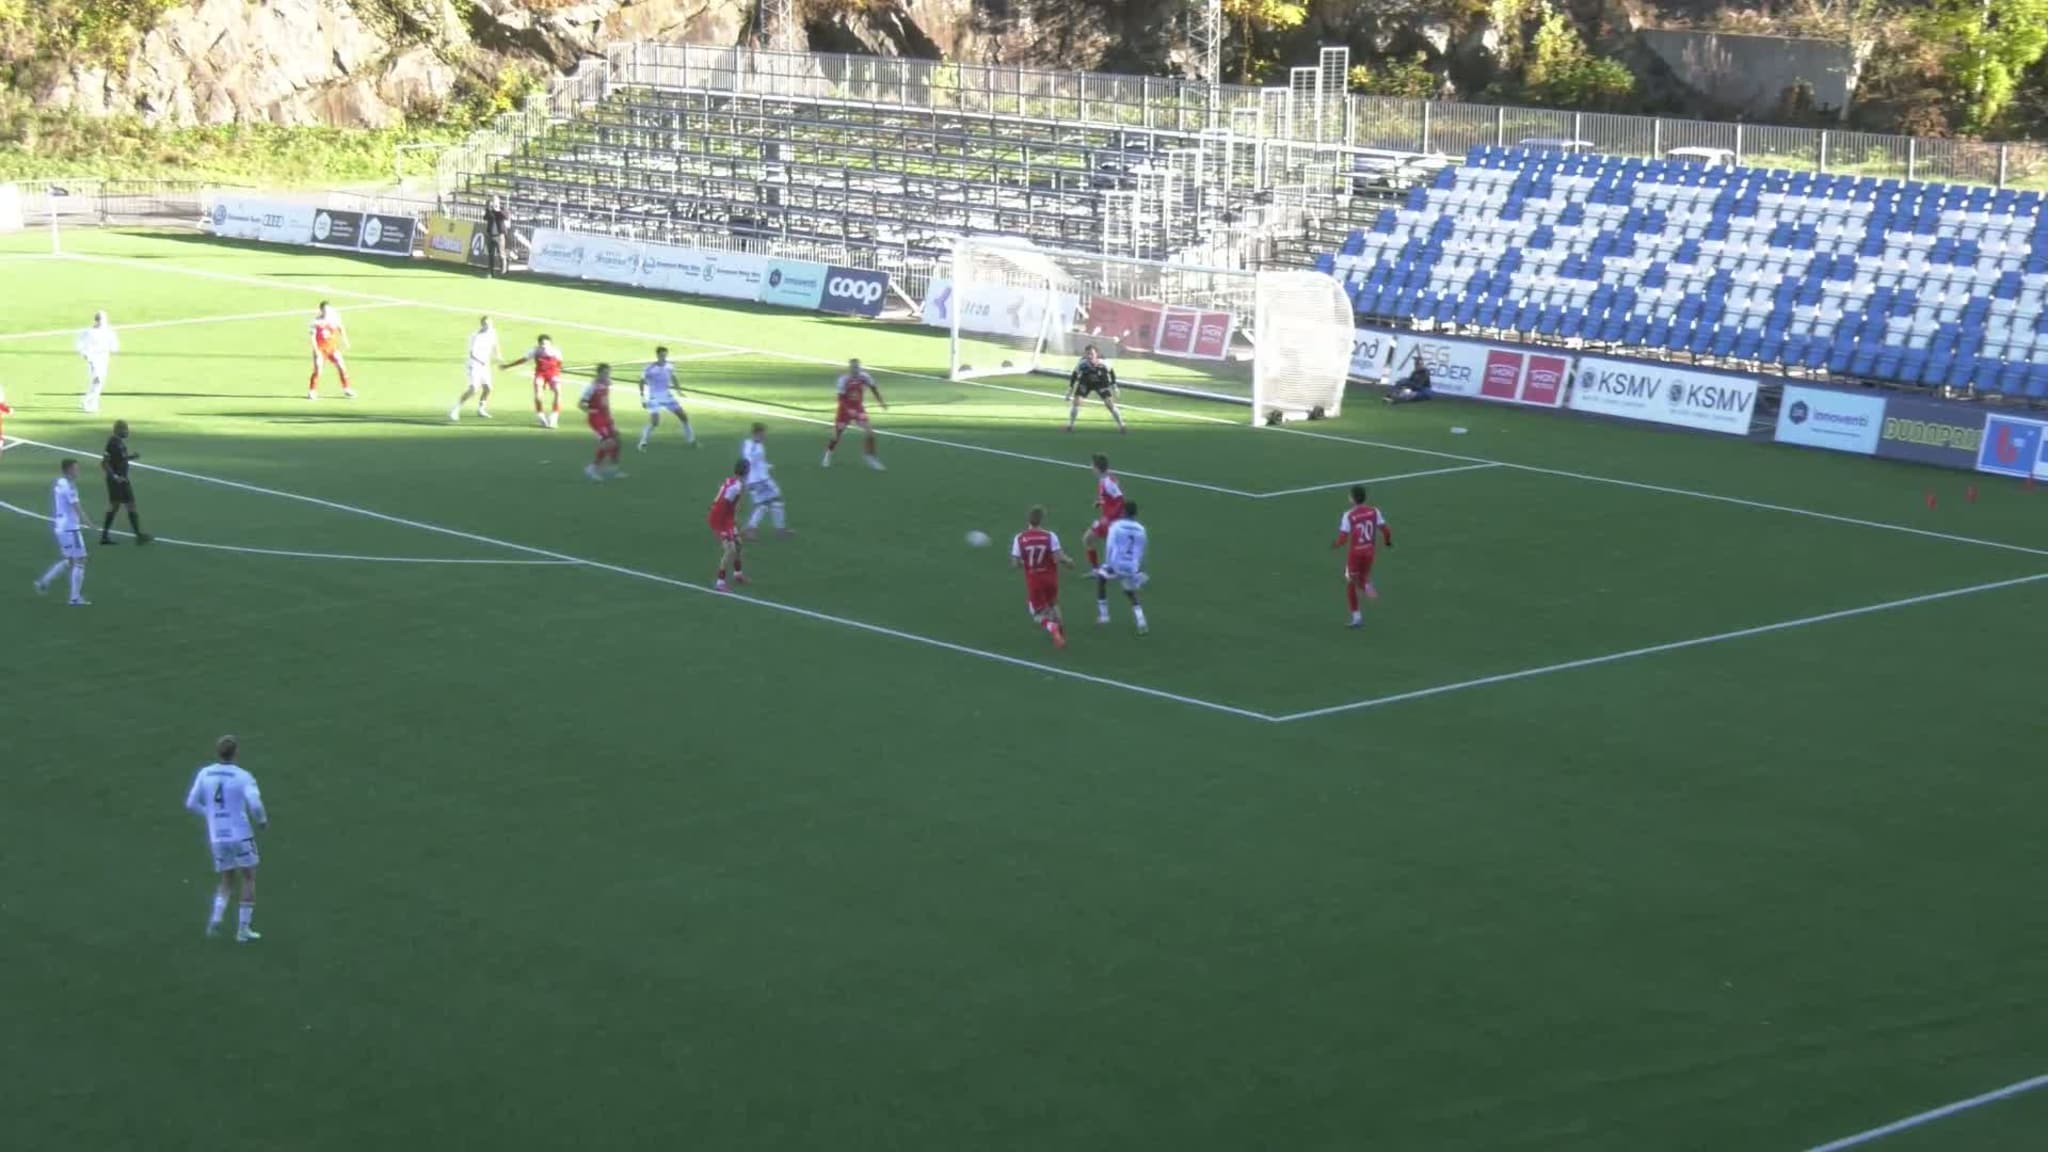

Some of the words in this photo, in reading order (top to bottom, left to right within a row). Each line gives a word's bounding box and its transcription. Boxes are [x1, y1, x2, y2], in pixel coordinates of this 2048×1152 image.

[829, 277, 882, 304] coop
[1598, 372, 1661, 400] KSMV
[1686, 384, 1752, 413] KSMV
[1356, 519, 1373, 544] 20
[1025, 545, 1046, 567] 77
[214, 782, 225, 810] 4
